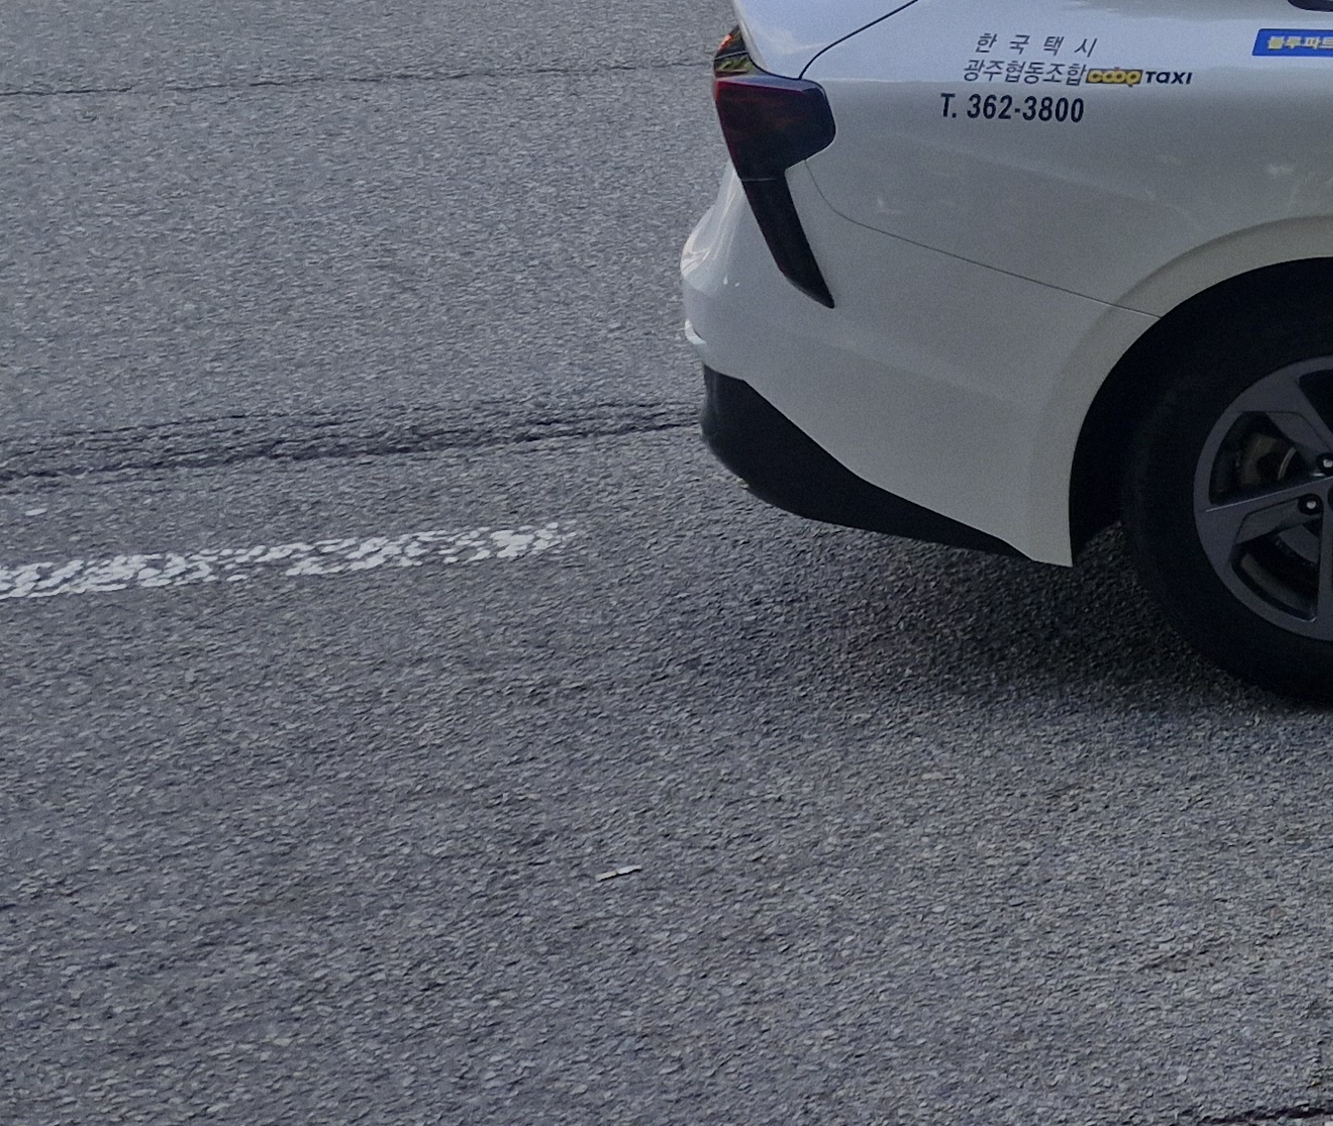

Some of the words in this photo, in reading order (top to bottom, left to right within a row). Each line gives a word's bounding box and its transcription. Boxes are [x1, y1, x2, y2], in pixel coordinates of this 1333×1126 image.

[964, 59, 1088, 87] 광주협동조합
[940, 92, 958, 119] T.
[966, 93, 1085, 123] 362-3800
